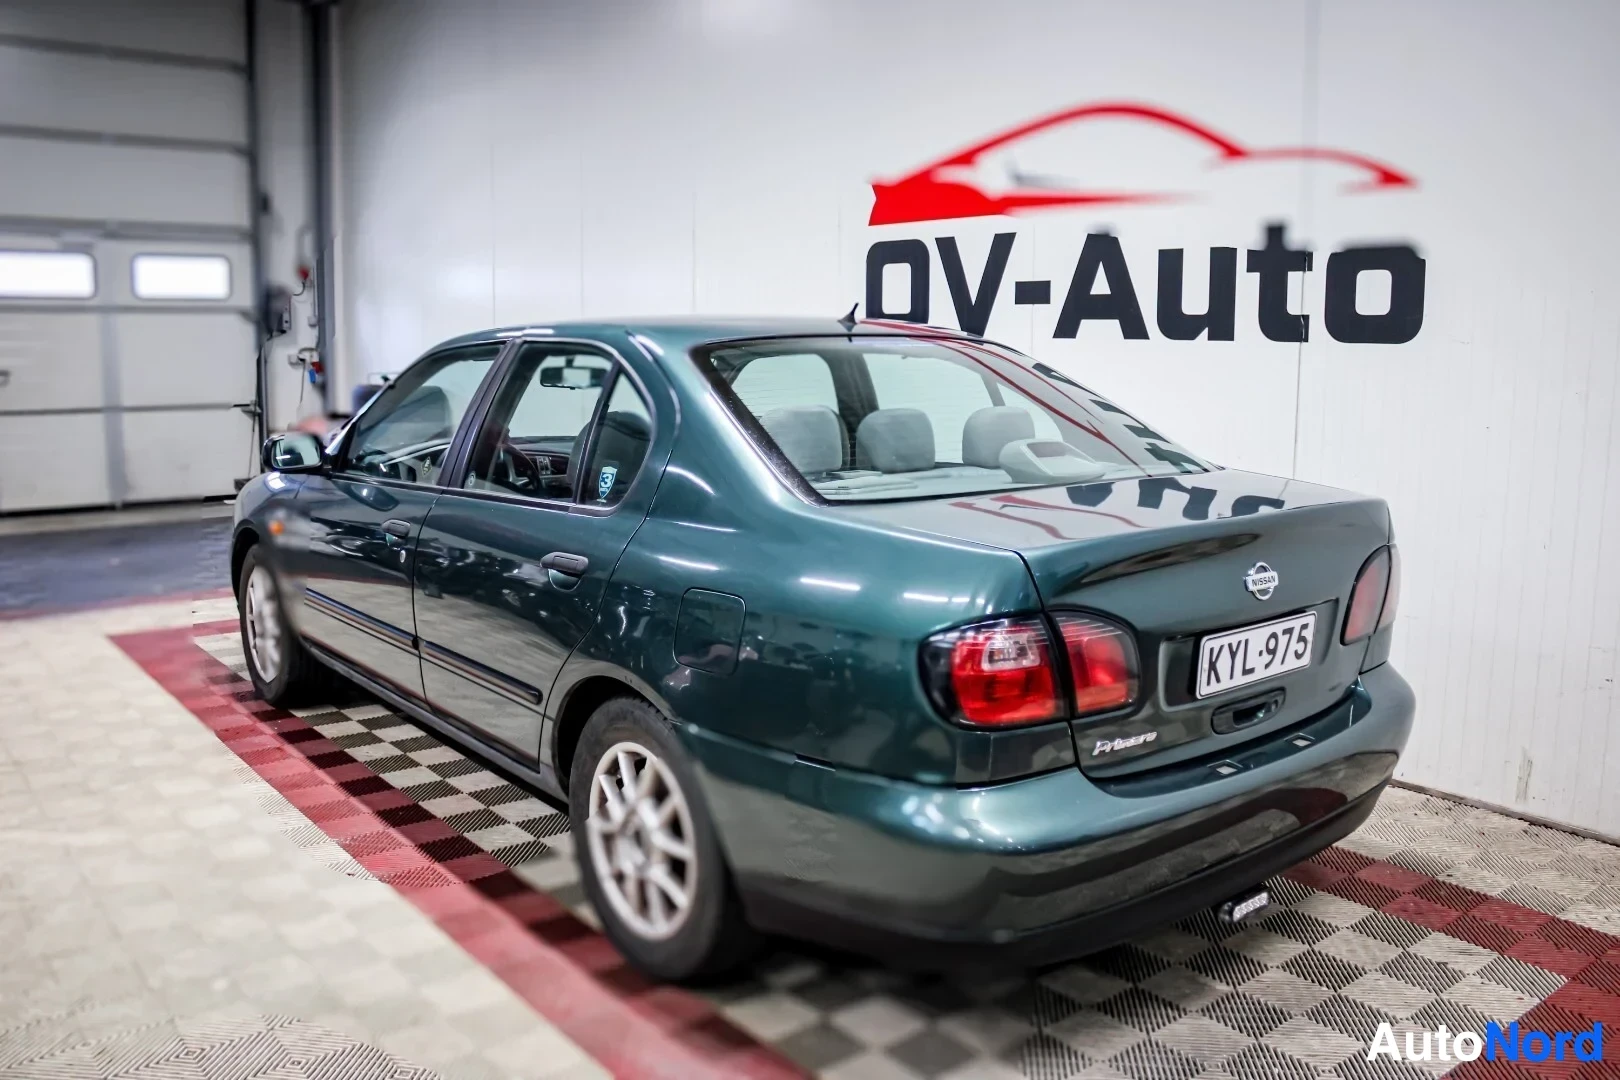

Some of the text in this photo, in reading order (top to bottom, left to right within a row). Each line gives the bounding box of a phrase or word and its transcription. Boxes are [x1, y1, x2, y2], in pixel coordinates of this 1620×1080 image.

[866, 221, 1426, 344] OV-Auto
[1251, 575, 1276, 587] NISSAN
[1206, 622, 1310, 687] KYL-975
